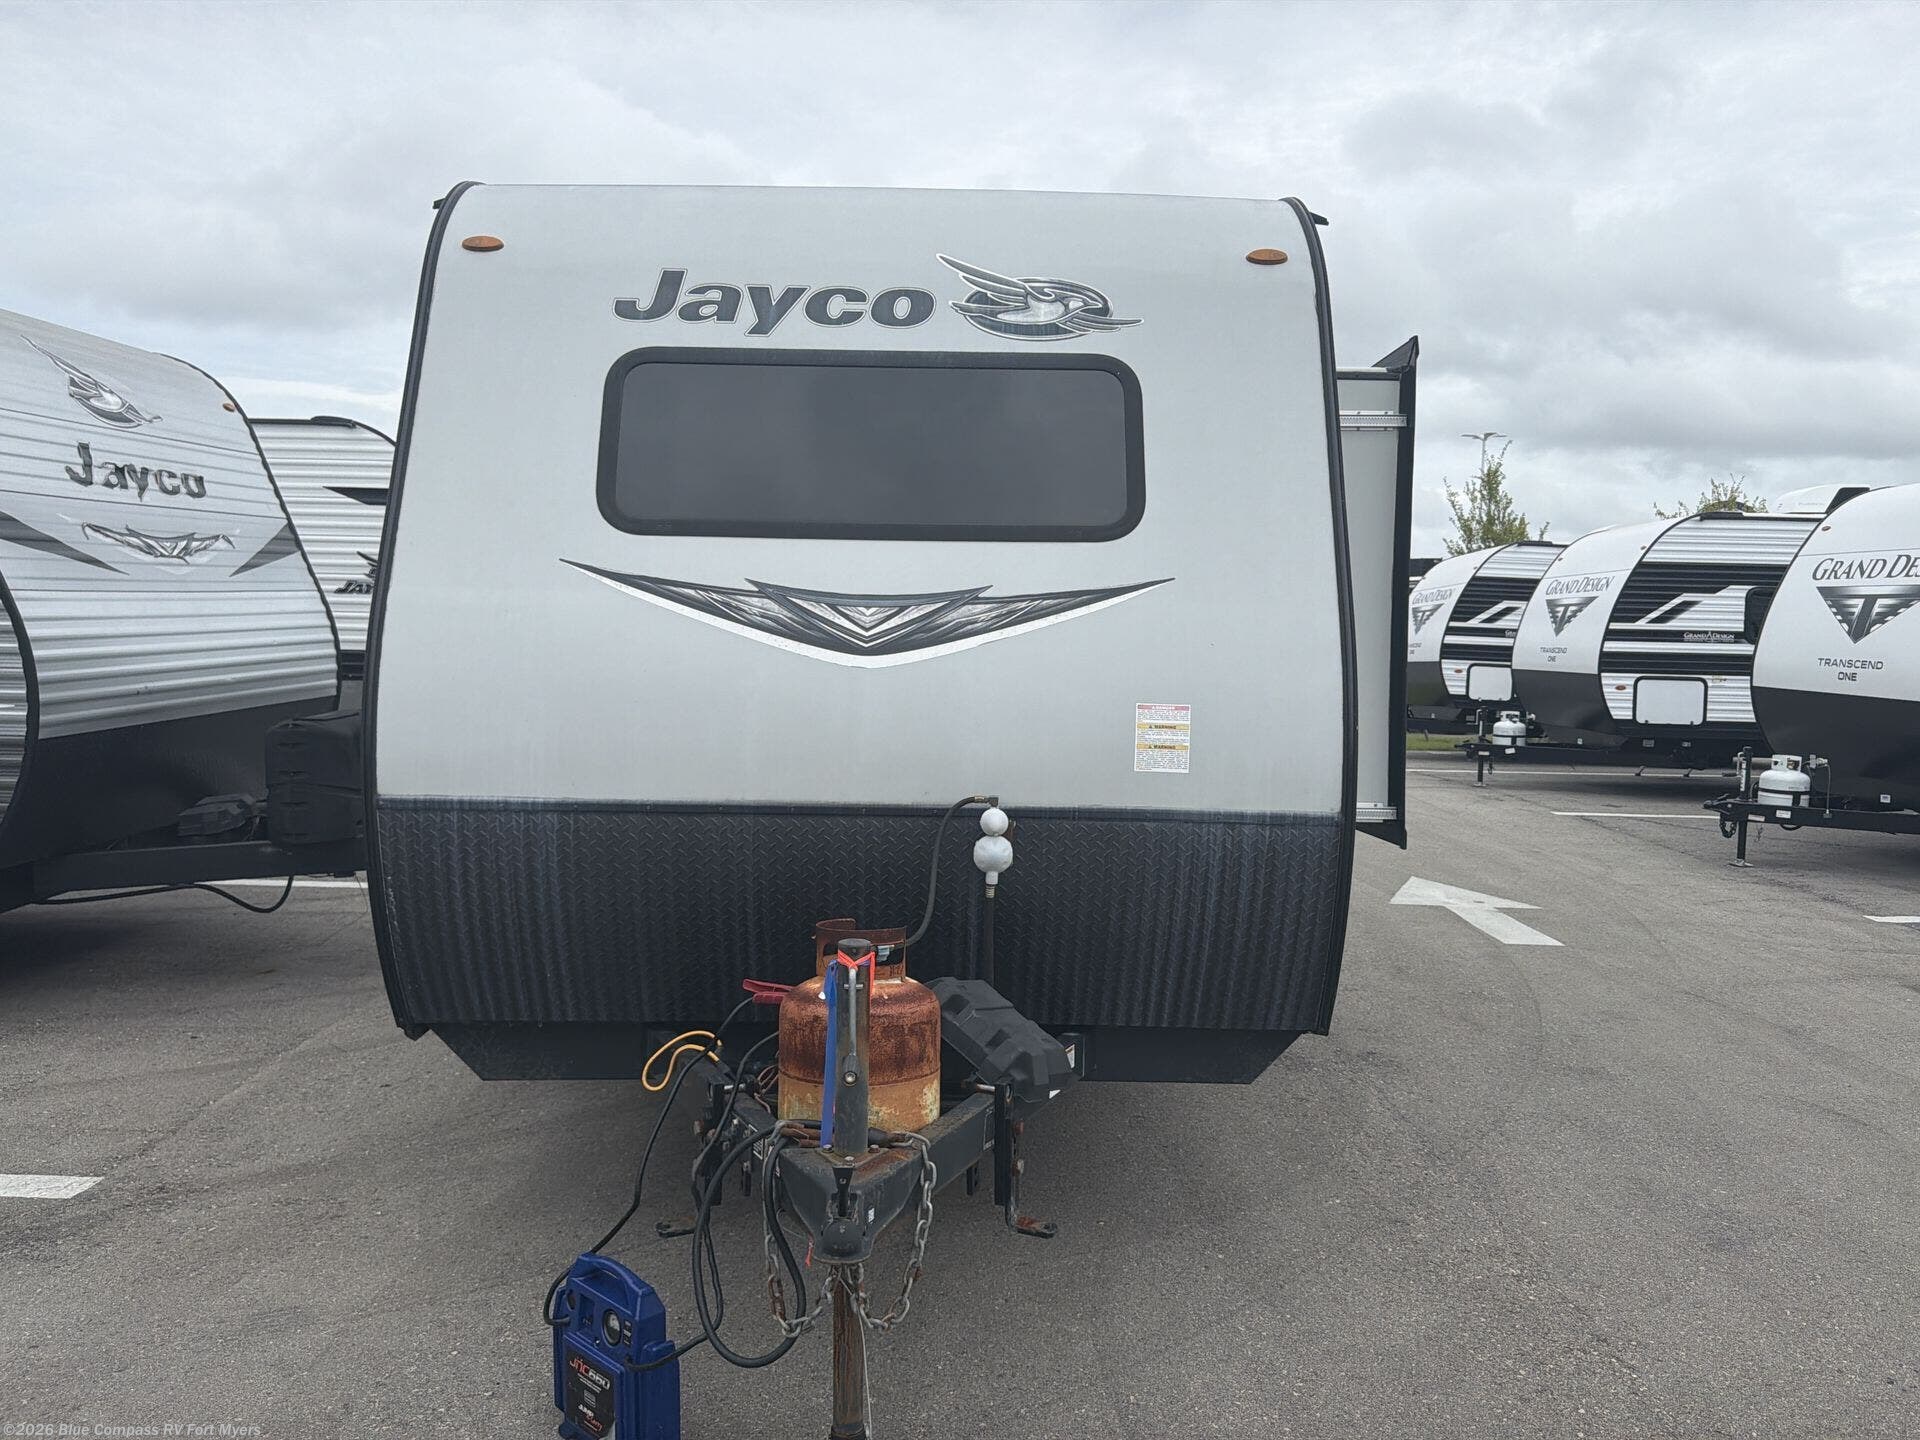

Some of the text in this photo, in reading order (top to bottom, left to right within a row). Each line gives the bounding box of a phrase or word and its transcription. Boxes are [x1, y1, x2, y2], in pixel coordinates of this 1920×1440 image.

[613, 267, 937, 337] Jayco
[1811, 558, 1888, 581] GRAND
[1545, 575, 1615, 595] GRAND DESIGN
[1683, 631, 1735, 639] GRAND DESIGN
[1540, 646, 1568, 655] TRANSCEND
[1817, 657, 1884, 670] TRANSCEND
[1837, 671, 1858, 682] ONE
